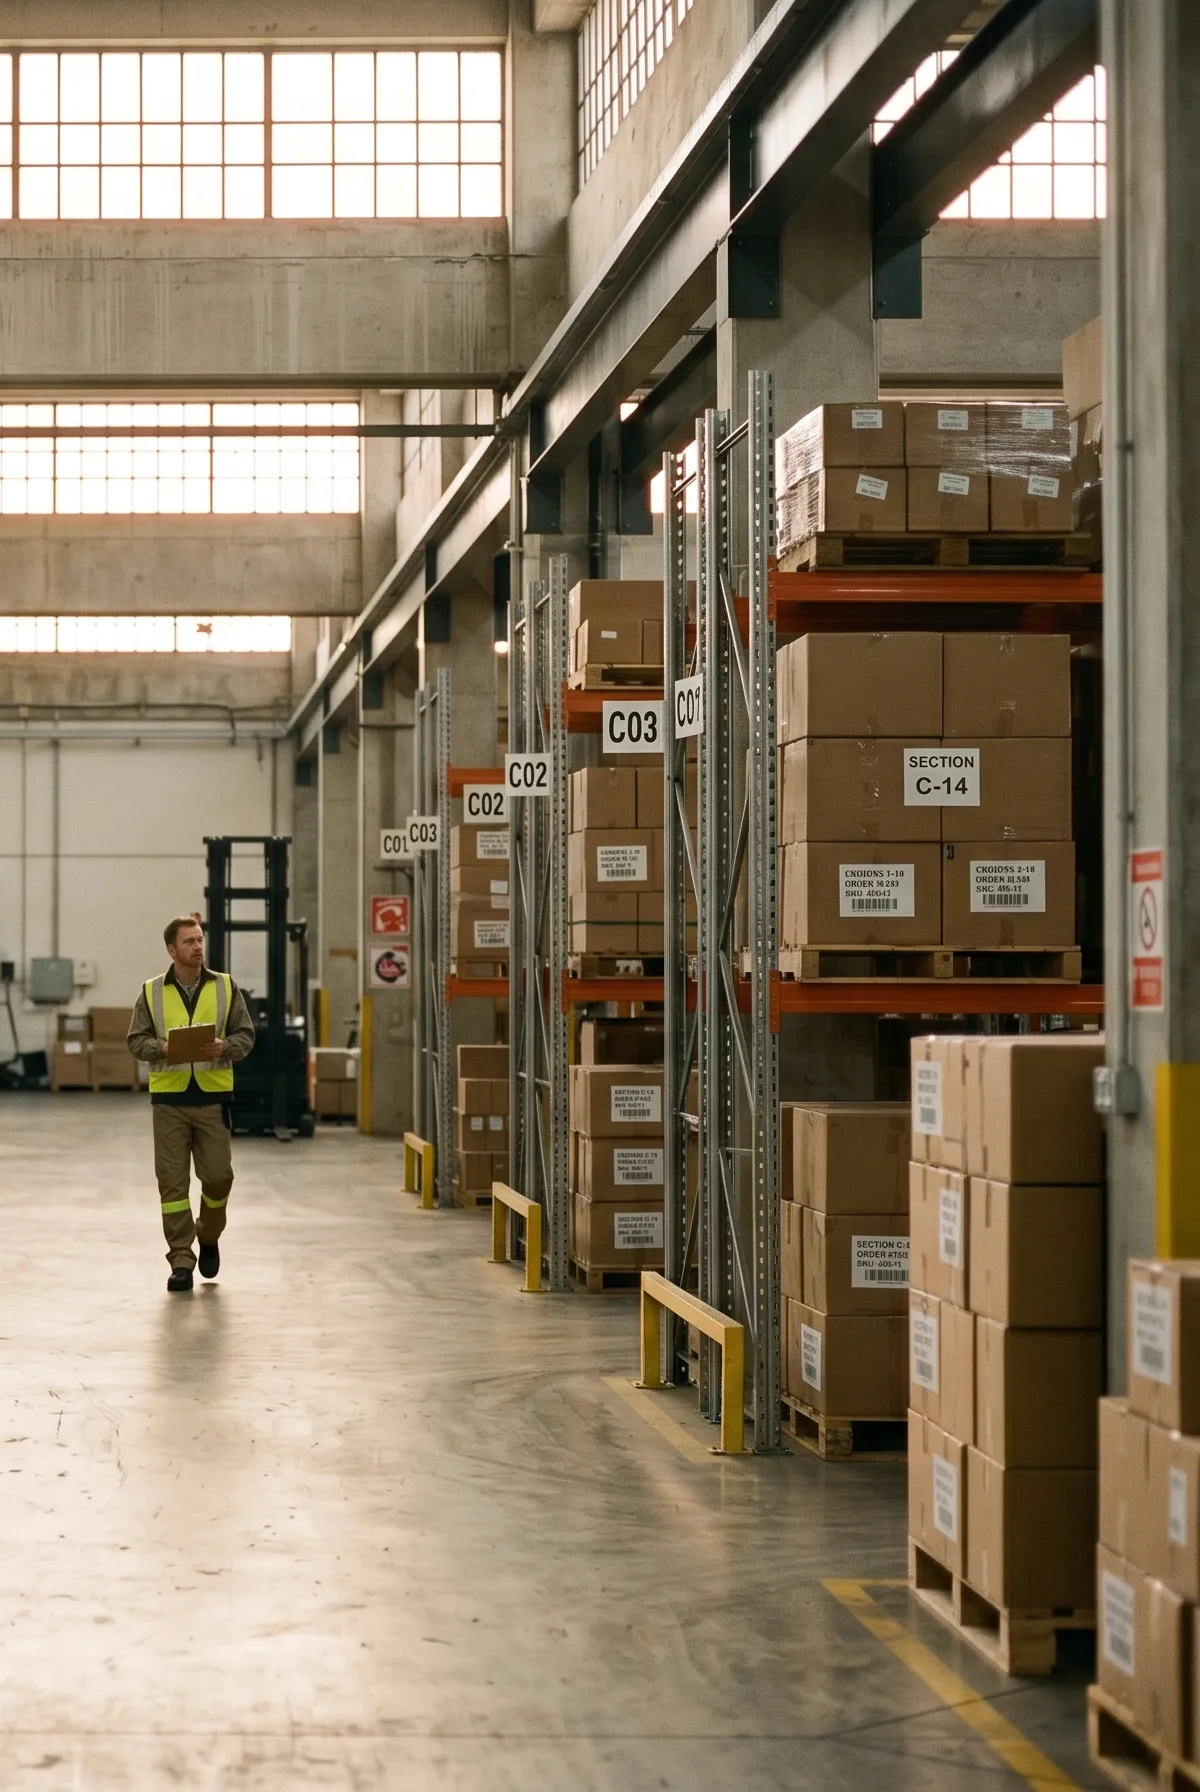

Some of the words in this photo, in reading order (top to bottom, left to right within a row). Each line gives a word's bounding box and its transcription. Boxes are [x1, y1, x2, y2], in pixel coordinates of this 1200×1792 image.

[609, 711, 657, 743] C03
[909, 756, 973, 768] SECTION
[510, 762, 546, 788] C02
[916, 777, 967, 794] C-14
[469, 793, 503, 816] C02
[410, 824, 436, 842] C03
[384, 835, 409, 853] C01
